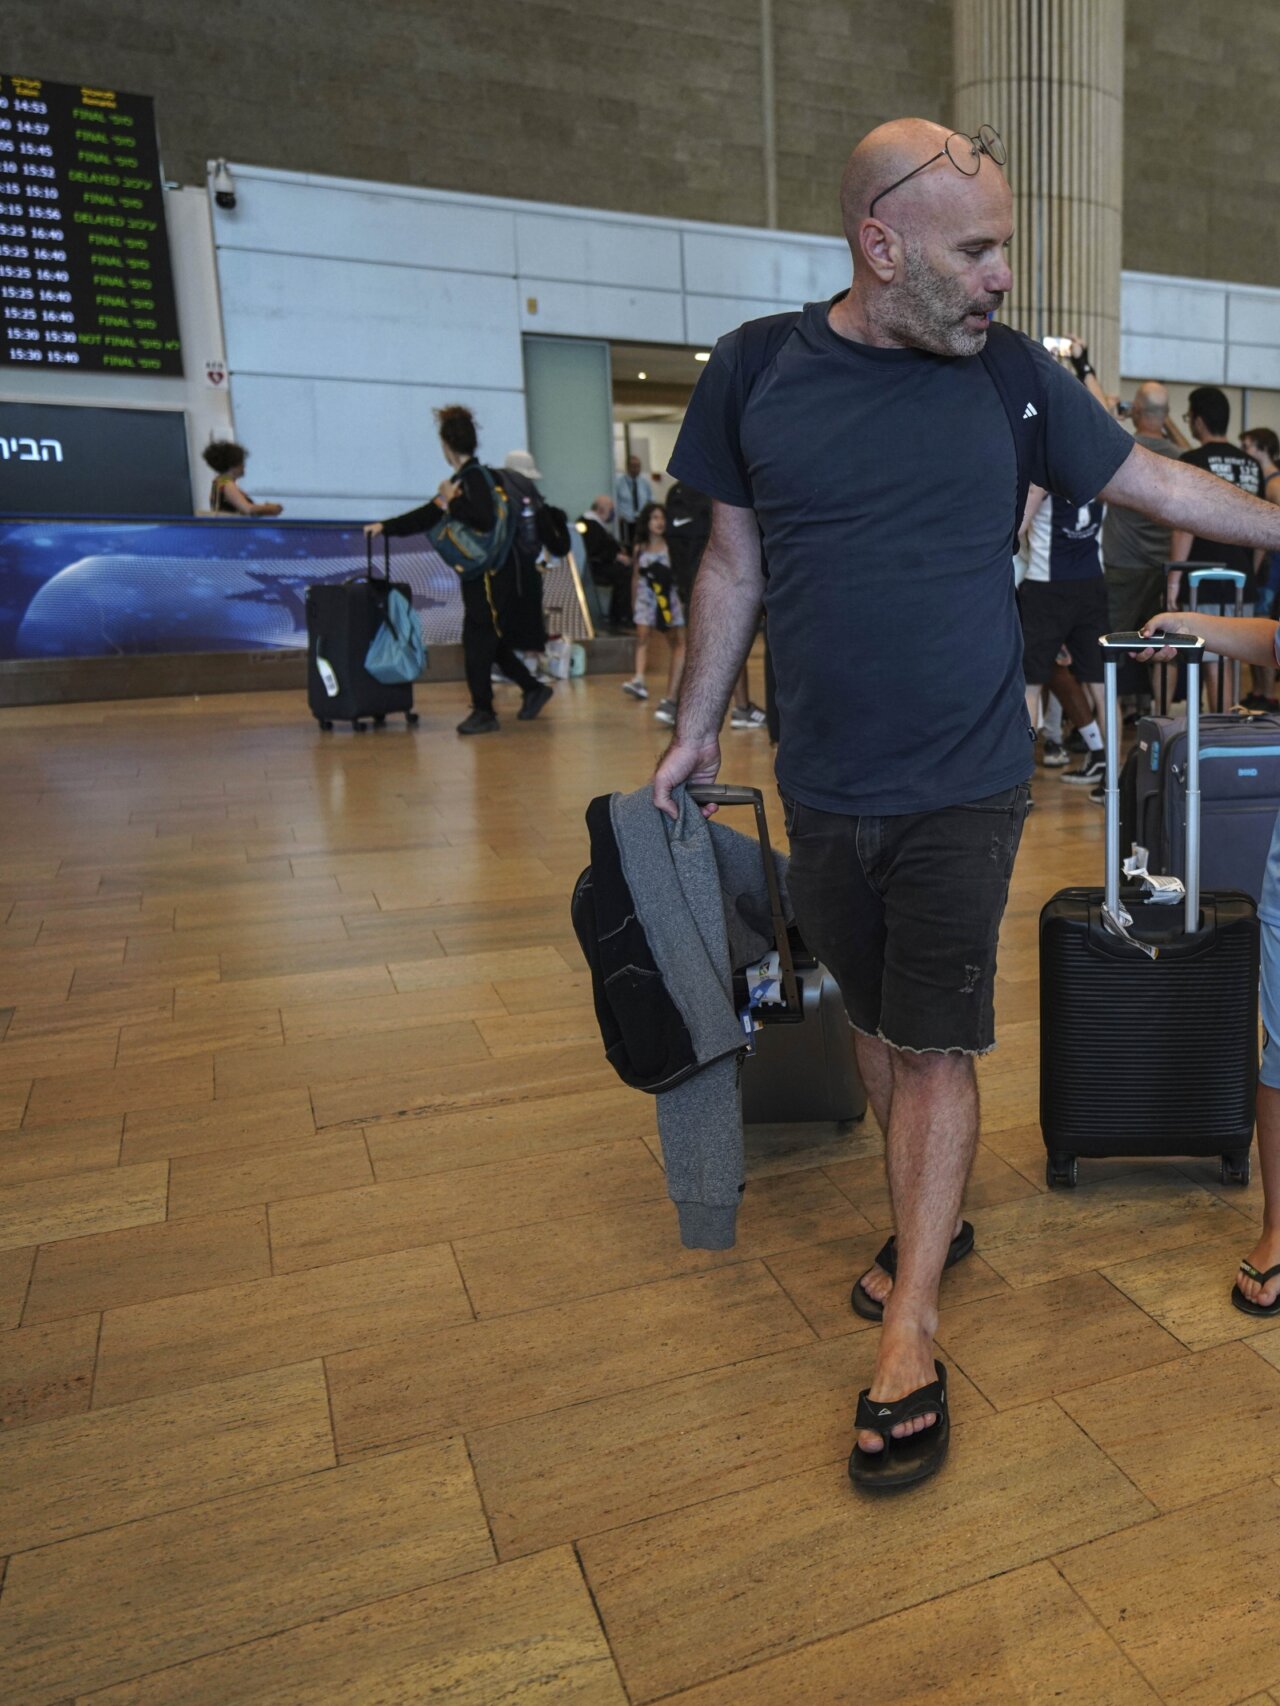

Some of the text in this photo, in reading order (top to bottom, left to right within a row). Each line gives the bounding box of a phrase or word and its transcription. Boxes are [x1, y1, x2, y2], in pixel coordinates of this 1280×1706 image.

[73, 109, 104, 121] FINAL
[76, 130, 107, 143] FINAL
[20, 143, 53, 157] 15:45
[79, 151, 110, 163] FINAL
[26, 185, 58, 199] 15:10
[84, 193, 115, 205] FINAL
[29, 206, 61, 220] 15:56
[31, 227, 64, 241] 16:40
[89, 234, 121, 247] FINAL
[34, 248, 66, 261] 16:40
[91, 254, 123, 267] FINAL
[0, 265, 31, 279] 15:25
[37, 269, 69, 282] 16:40
[94, 275, 125, 287] FINAL
[2, 286, 34, 299] 15:25
[40, 289, 72, 303] 16:40
[96, 295, 128, 308] FINAL
[4, 307, 37, 320] 15:25
[42, 310, 74, 323] 16:40
[98, 315, 130, 327] FINAL
[7, 328, 40, 340] 15:30
[45, 331, 77, 343] 15:30
[78, 334, 101, 345] NOT
[104, 336, 136, 348] FINAL
[10, 348, 42, 361] 15:30
[48, 351, 79, 363] 15:40
[103, 355, 135, 367] FINAL
